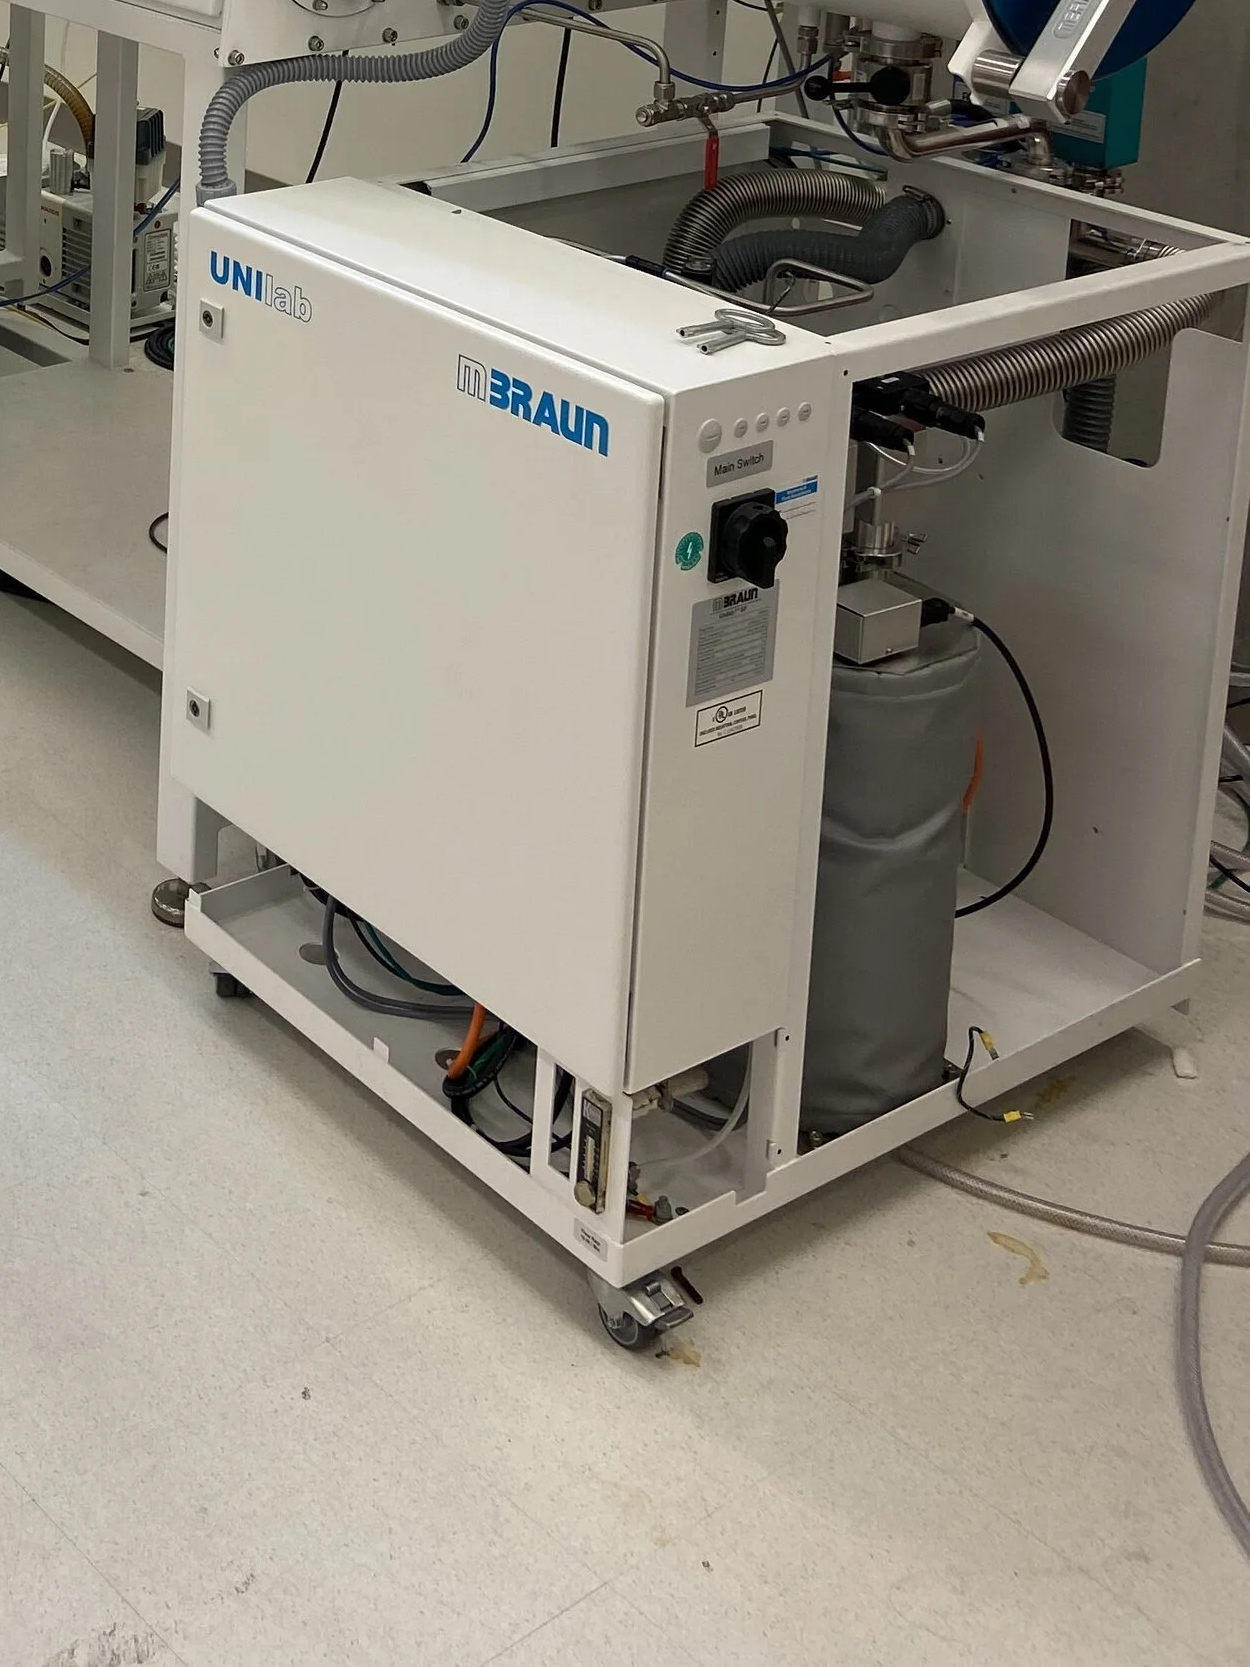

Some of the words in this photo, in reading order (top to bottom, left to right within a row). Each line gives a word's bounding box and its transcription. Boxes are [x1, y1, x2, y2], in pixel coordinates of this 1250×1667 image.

[211, 250, 312, 322] UNIlab
[714, 462, 735, 476] Main
[737, 453, 764, 470] Switch
